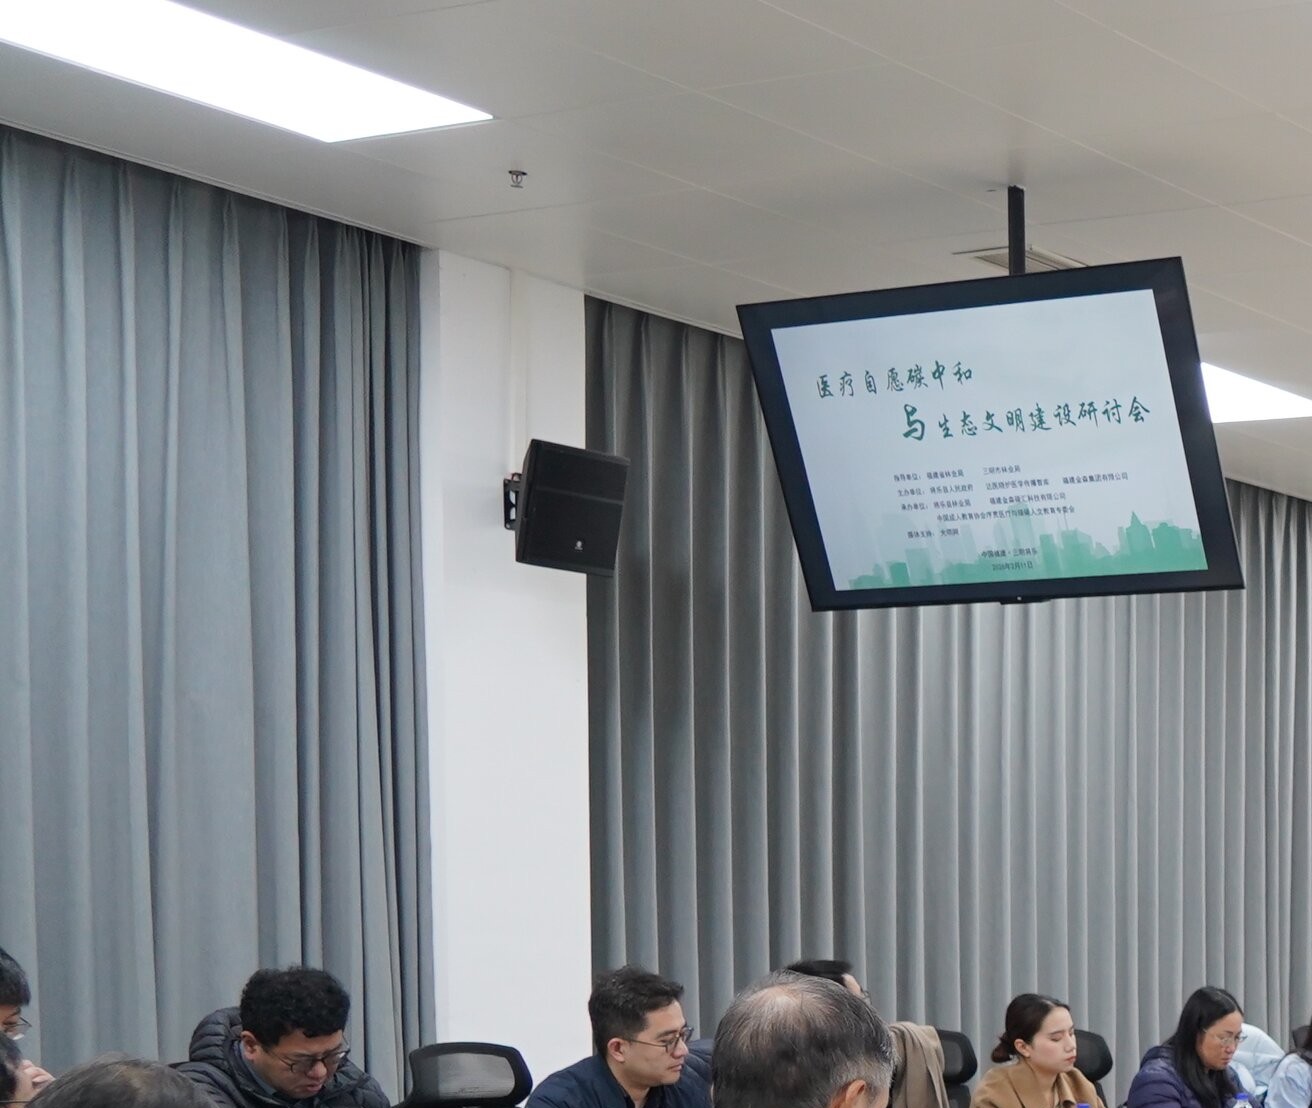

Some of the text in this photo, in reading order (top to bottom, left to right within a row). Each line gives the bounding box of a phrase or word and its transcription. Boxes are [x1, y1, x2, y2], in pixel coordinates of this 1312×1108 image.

[817, 359, 974, 400] 医疗自愿碳中和
[902, 395, 1151, 441] 与生态文明建设研讨会
